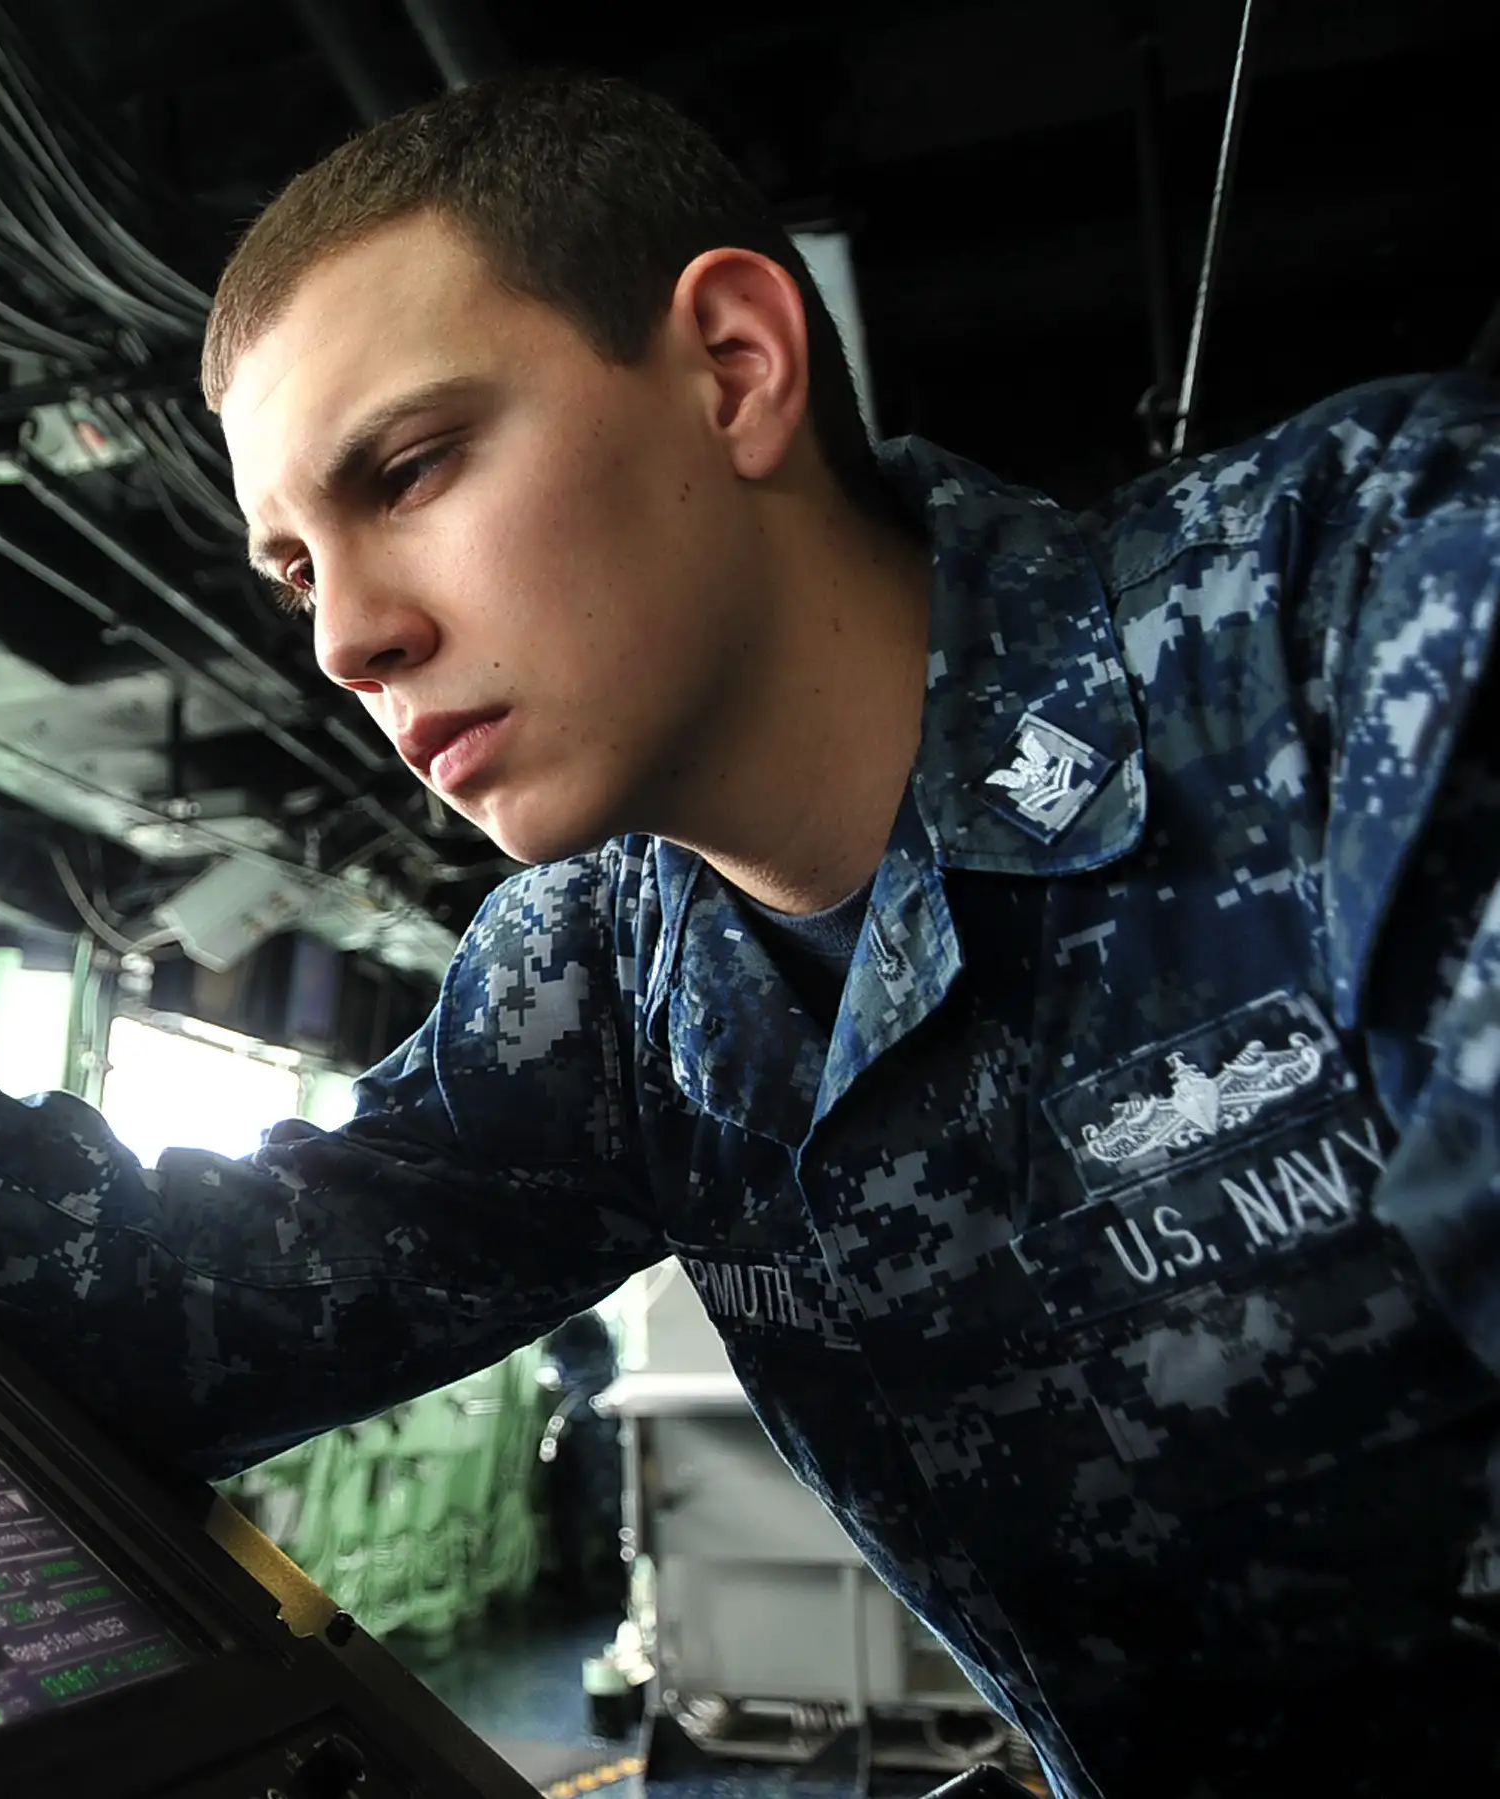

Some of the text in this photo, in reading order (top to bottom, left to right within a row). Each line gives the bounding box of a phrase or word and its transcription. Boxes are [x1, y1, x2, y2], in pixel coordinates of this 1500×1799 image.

[1104, 1117, 1389, 1284] U.S. NAVY
[2, 1640, 51, 1662] Range
[80, 1615, 132, 1642] UNDER
